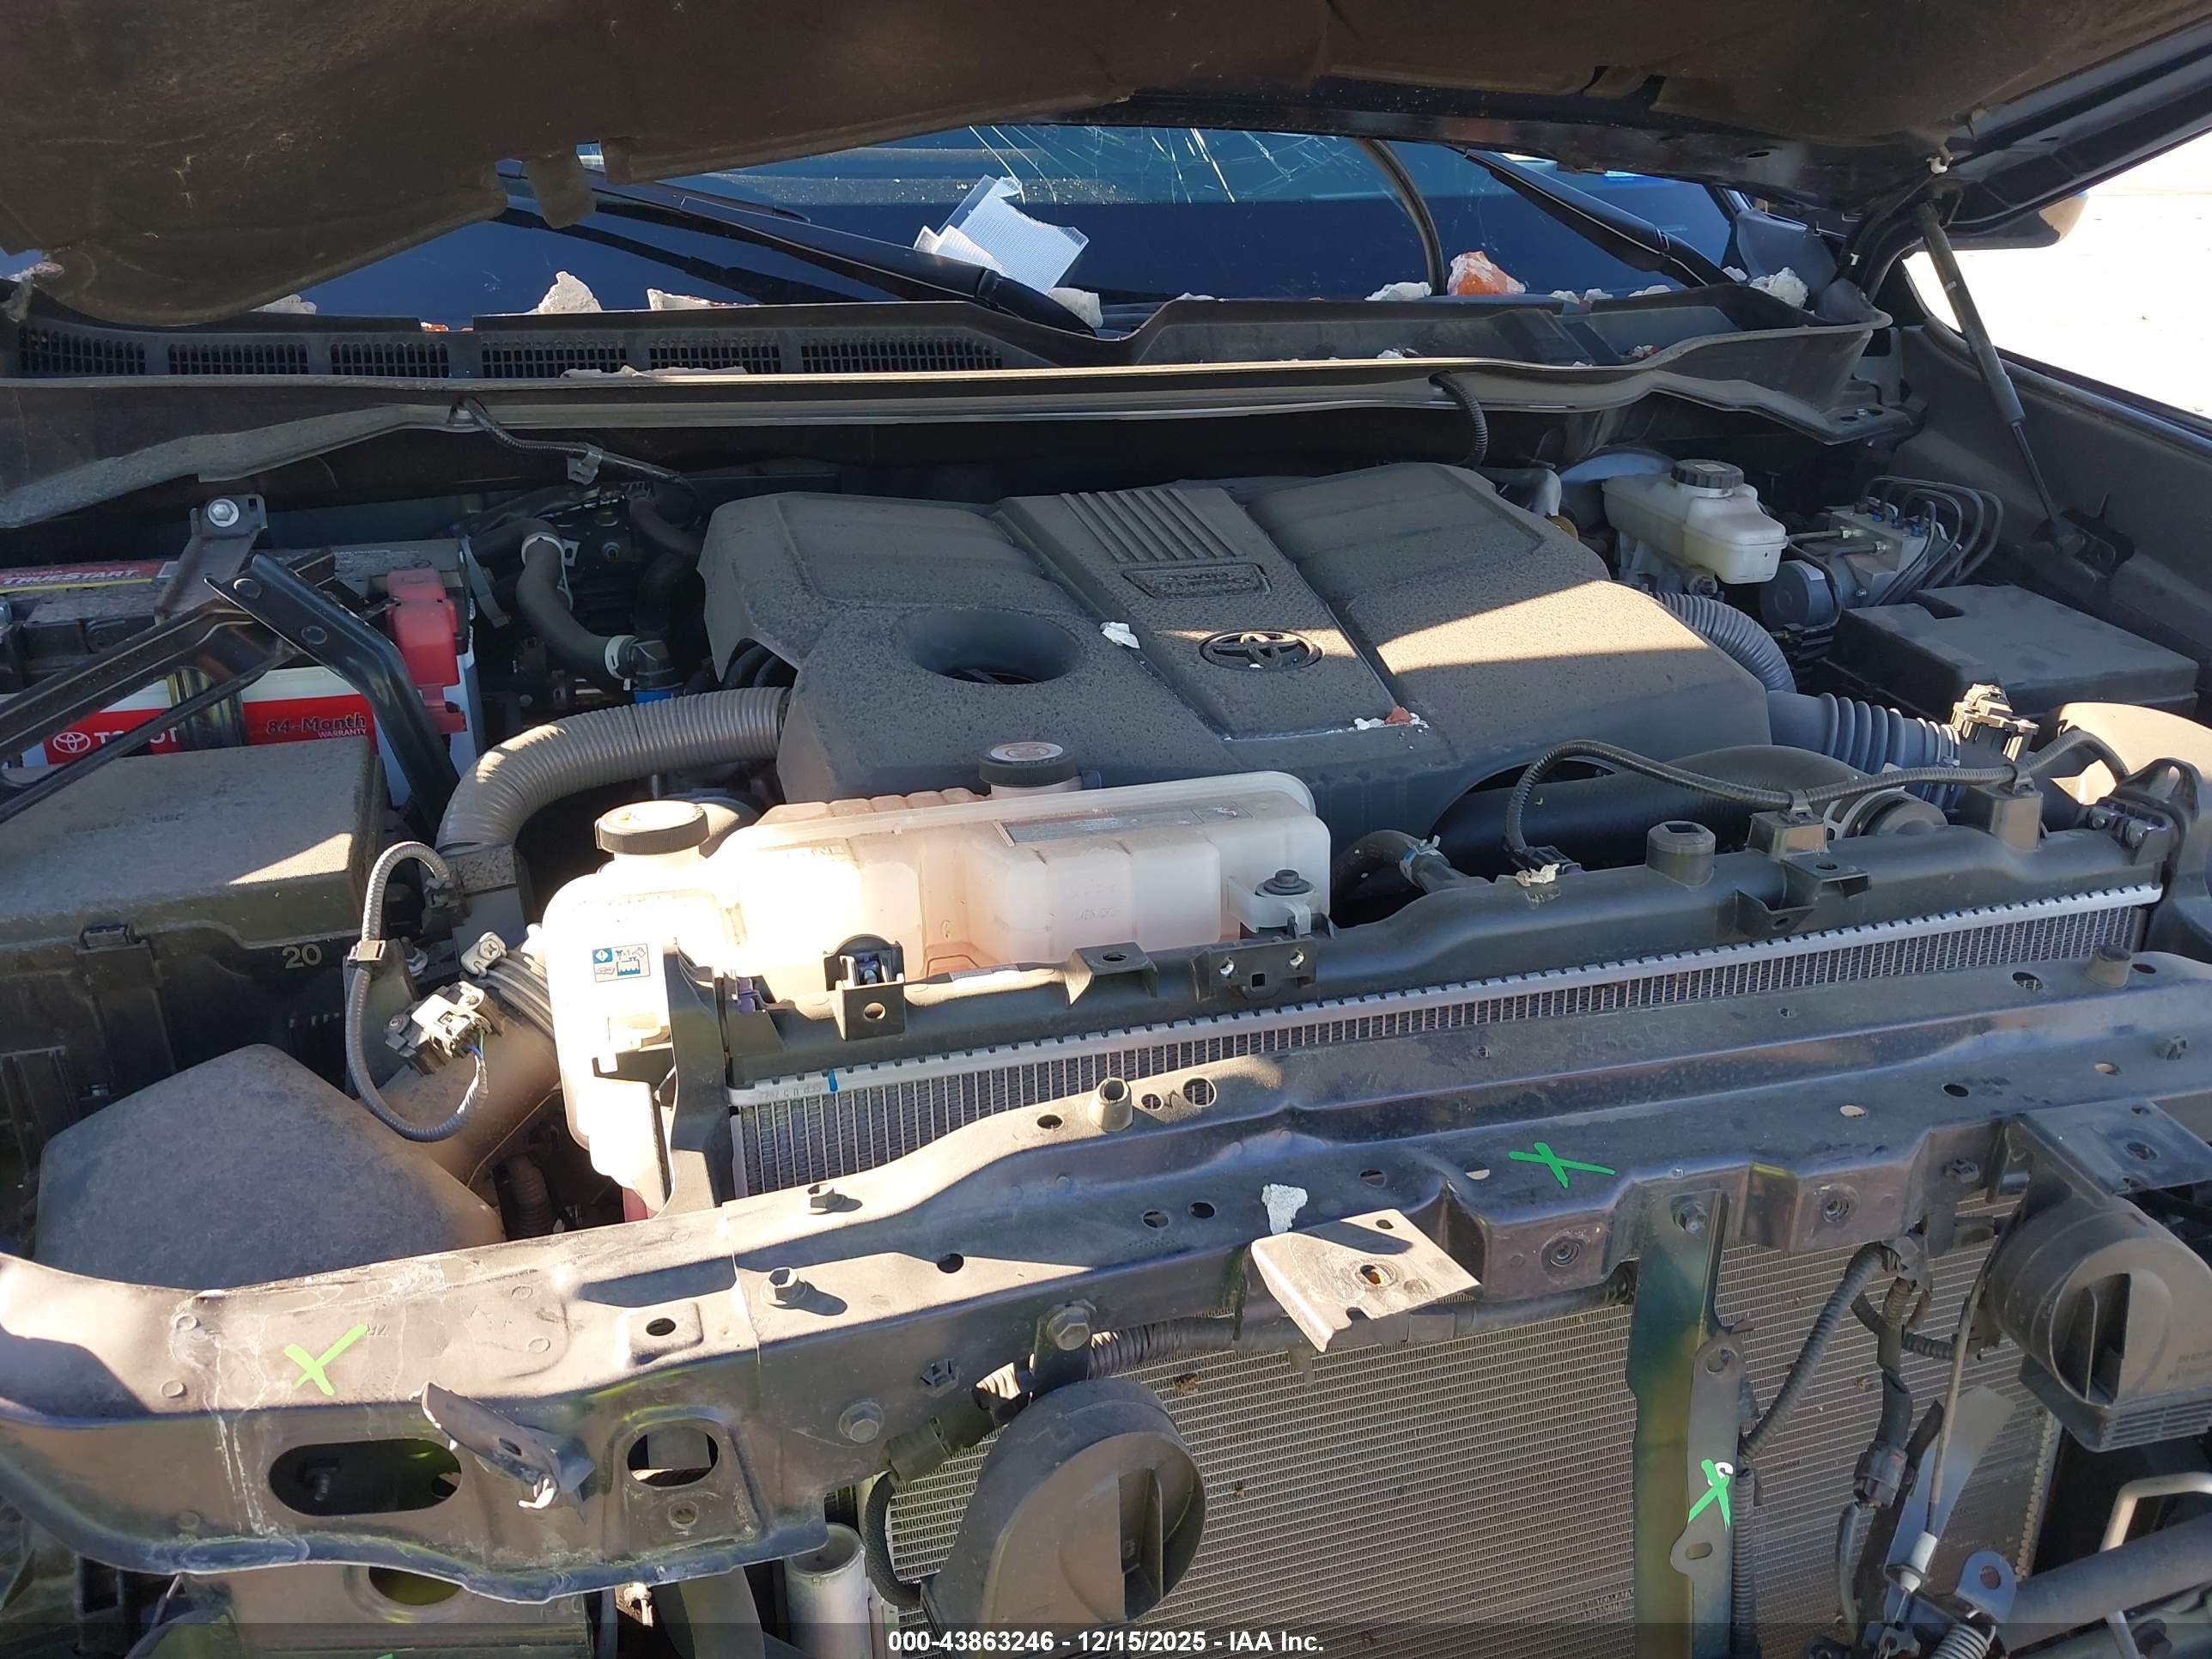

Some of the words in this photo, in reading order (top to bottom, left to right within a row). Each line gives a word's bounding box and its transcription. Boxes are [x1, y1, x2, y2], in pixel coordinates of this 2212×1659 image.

[3, 568, 141, 586] TRUESTART
[266, 712, 366, 735] 84-Month
[317, 727, 367, 738] WARRANTY
[282, 943, 323, 969] 20
